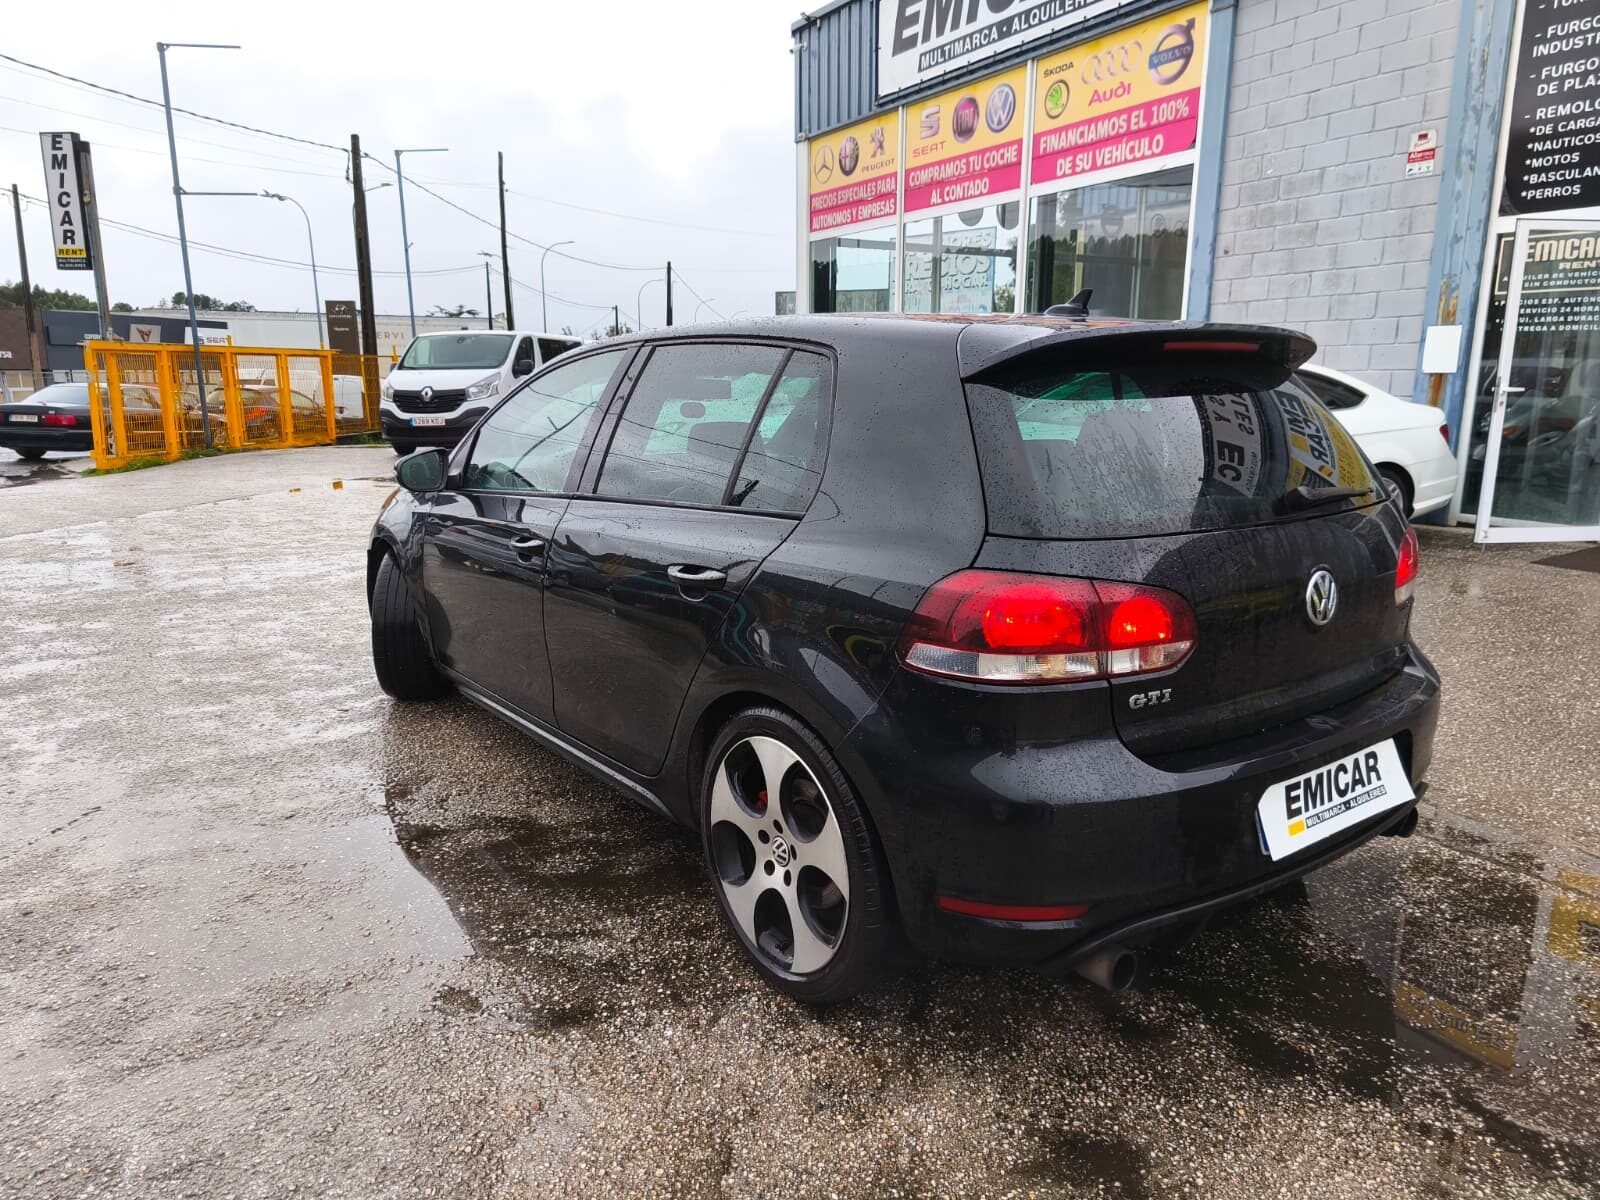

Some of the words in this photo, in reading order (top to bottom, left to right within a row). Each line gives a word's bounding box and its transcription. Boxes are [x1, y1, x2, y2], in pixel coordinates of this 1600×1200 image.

[921, 25, 998, 70] MULTIMARCA
[1151, 44, 1191, 64] VOLVO
[1541, 57, 1599, 80] FURGO
[1088, 81, 1131, 107] Audi
[1536, 80, 1559, 97] DE
[1039, 113, 1128, 156] FINANCIAMOS
[1130, 107, 1147, 130] EL
[1150, 96, 1189, 125] 100%
[909, 158, 967, 186] COMPRAMOS
[969, 154, 982, 171] TU
[983, 144, 1018, 168] COCHE
[912, 140, 946, 158] SEAT
[1056, 157, 1073, 176] DE
[1075, 152, 1092, 172] SU
[1095, 133, 1164, 167] VEHÍCULO
[861, 158, 895, 173] PEUGEOT
[51, 134, 76, 245] EMICAR
[811, 191, 837, 211] PRECIOS
[838, 180, 876, 205] ESPECIALES
[877, 177, 896, 194] PARA
[930, 189, 943, 205] AL
[943, 178, 989, 201] CONTADO
[812, 208, 851, 230] AUTONOMOS
[852, 207, 858, 222] Y
[858, 198, 895, 219] EMPRESAS
[1128, 688, 1173, 710] GTI
[1285, 750, 1382, 820] EMICAR
[1306, 804, 1346, 827] MULTIMARCA
[1350, 786, 1386, 807] ALQUILERES
